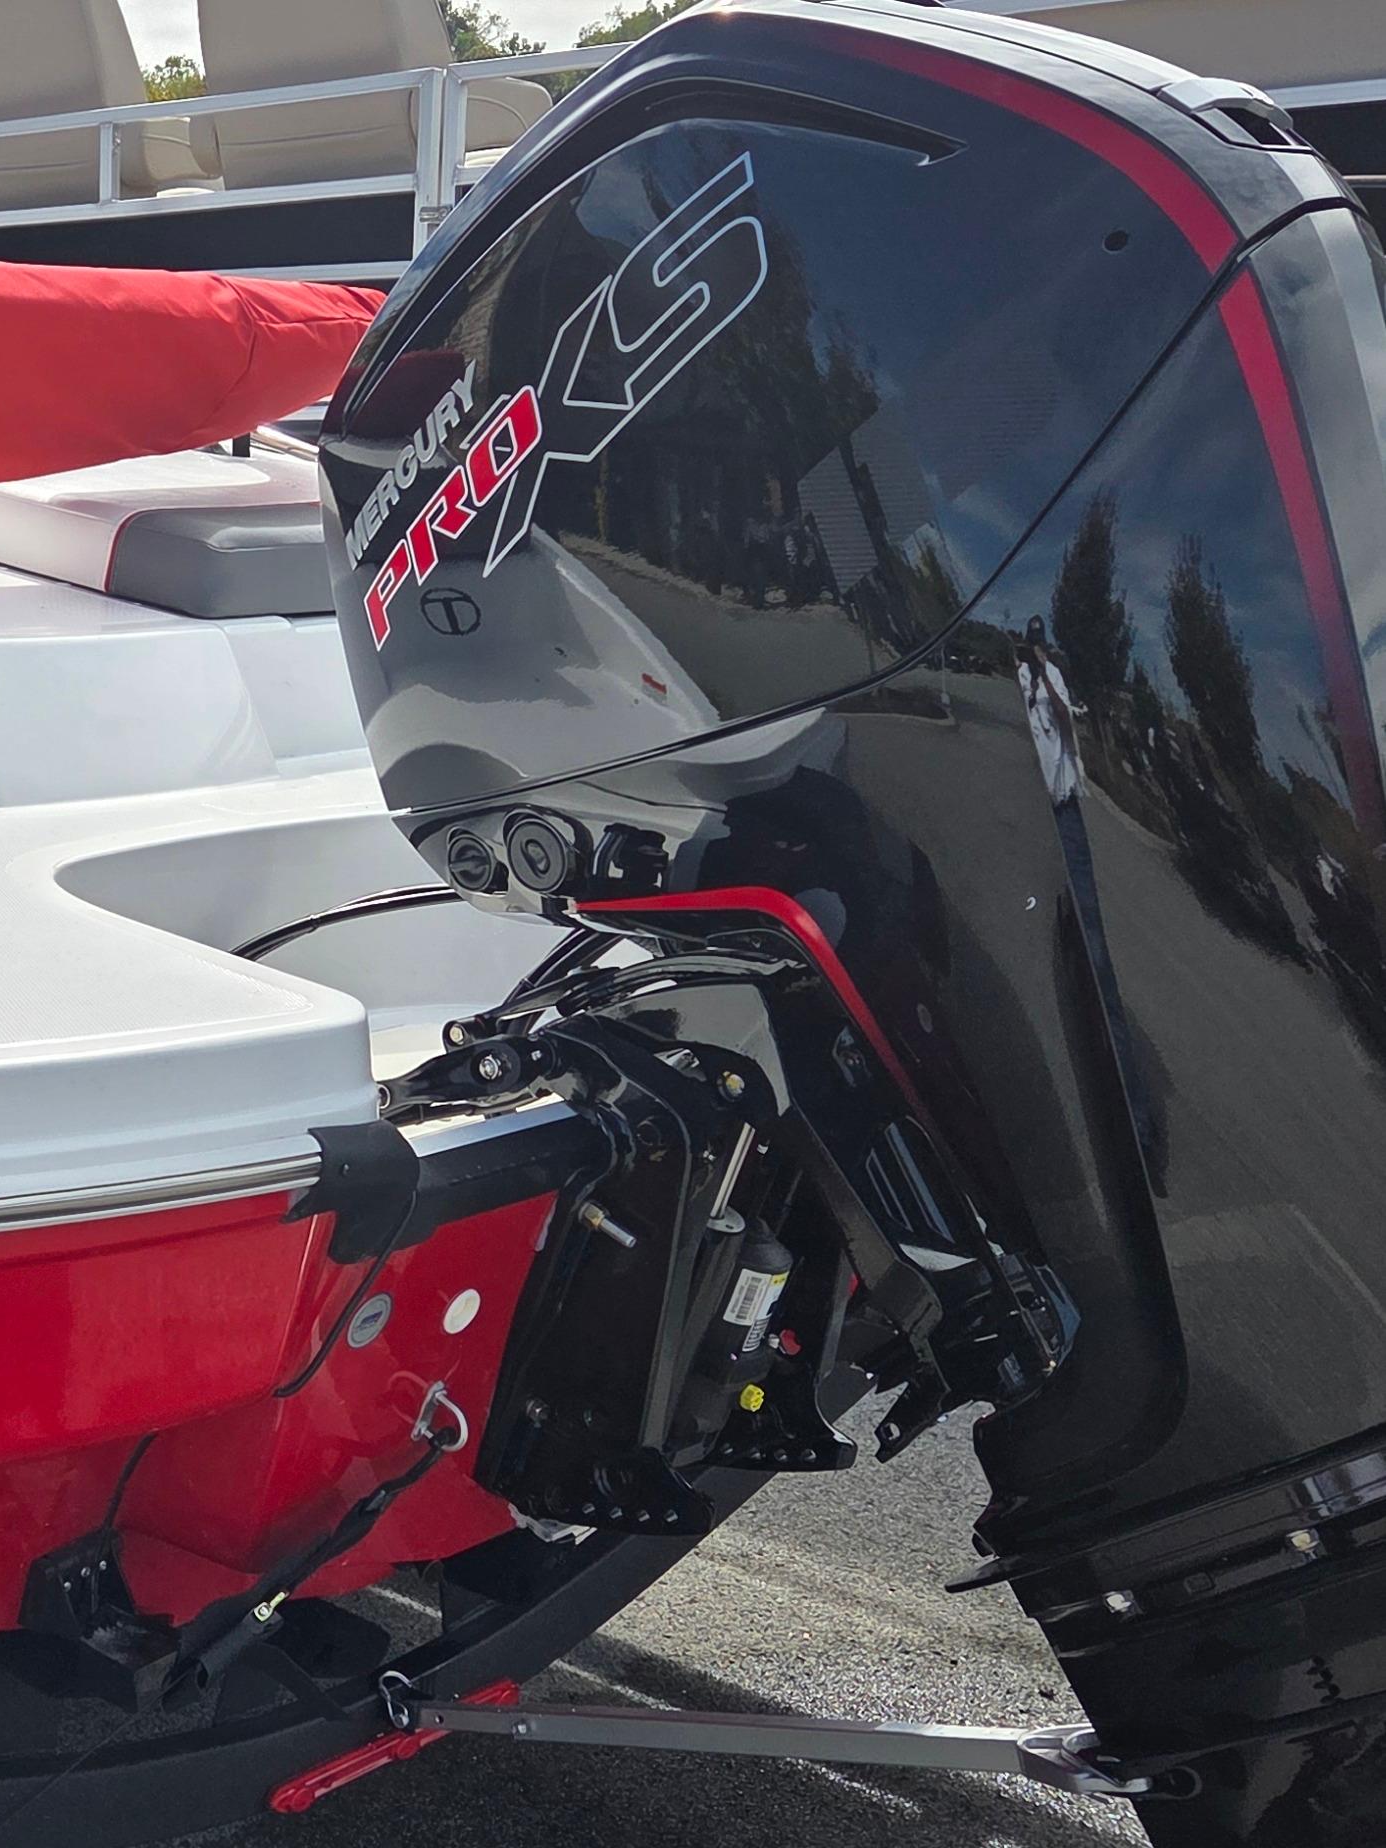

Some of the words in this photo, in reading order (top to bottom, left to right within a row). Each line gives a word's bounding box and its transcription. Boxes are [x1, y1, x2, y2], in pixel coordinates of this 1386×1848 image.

[345, 359, 476, 571] MERCURY
[364, 385, 542, 652] PRO
[459, 151, 768, 578] XS
